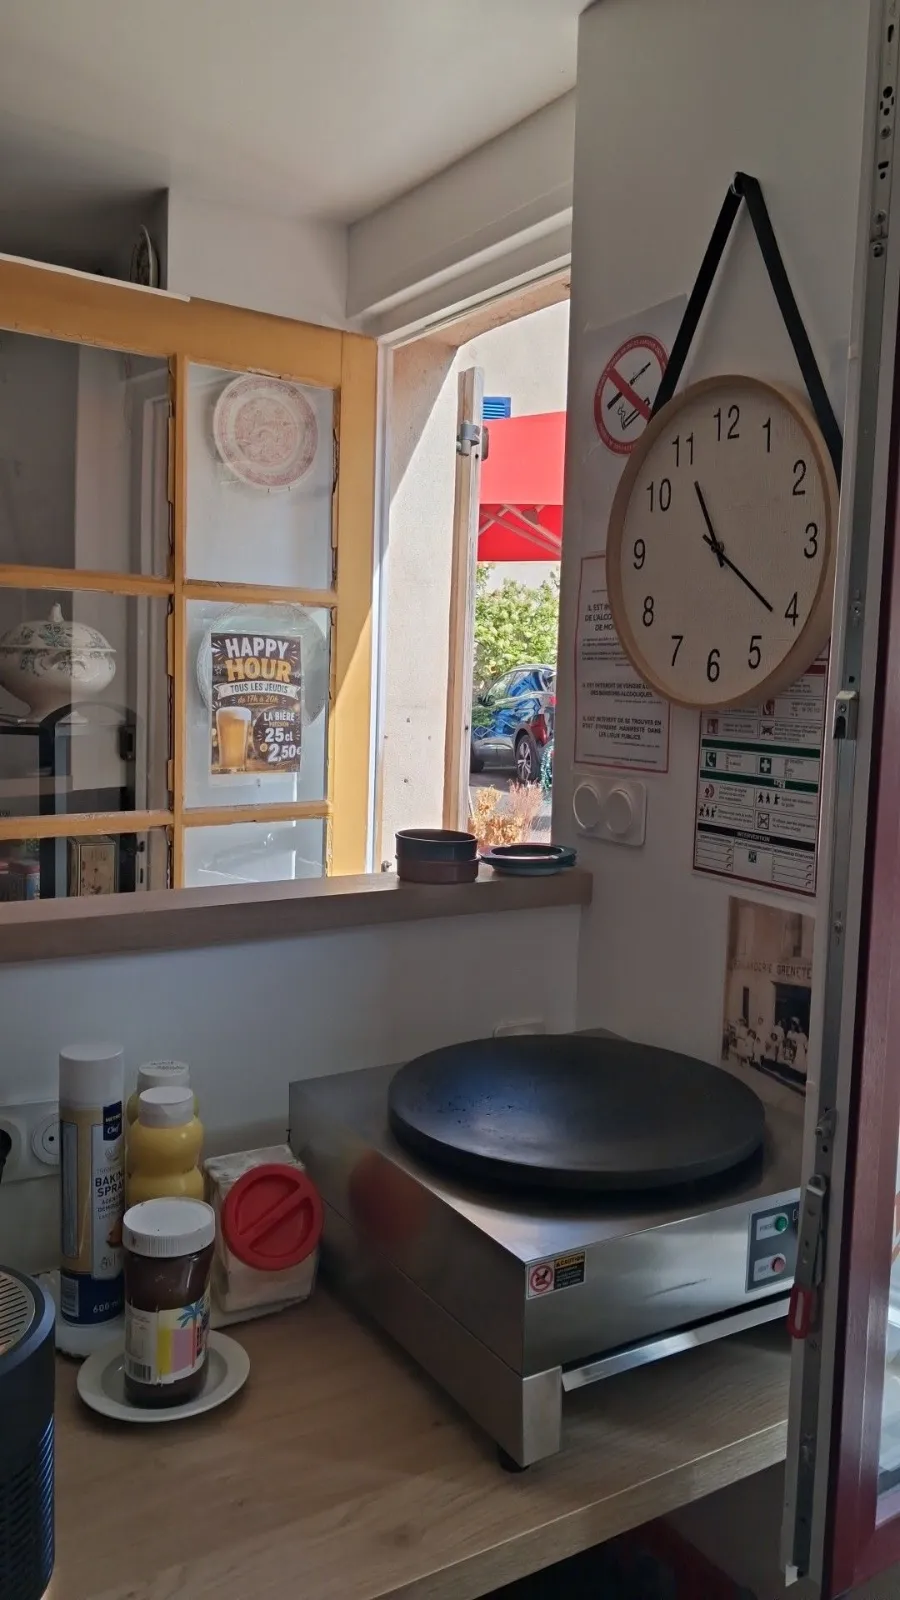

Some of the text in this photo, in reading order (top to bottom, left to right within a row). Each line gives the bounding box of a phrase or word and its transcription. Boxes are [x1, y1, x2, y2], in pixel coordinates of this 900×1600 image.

[713, 405, 740, 442] 12
[762, 417, 770, 453] 1
[672, 432, 694, 467] 11
[792, 459, 806, 496] 2
[646, 478, 672, 513] 10
[633, 539, 645, 569] 9
[804, 522, 818, 558] 3
[584, 614, 592, 622] DE
[642, 595, 655, 627] 8
[784, 591, 799, 627] 4
[225, 637, 290, 659] HAPPY
[671, 635, 684, 667] 7
[747, 635, 762, 669] 5
[224, 657, 292, 682] HOUR
[706, 648, 720, 682] 6
[230, 682, 288, 693] TOUS LES JEUDIS
[263, 712, 273, 721] LA
[265, 728, 293, 742] 25 cl
[97, 1181, 123, 1197] SPRA
[93, 1302, 110, 1314] 600
